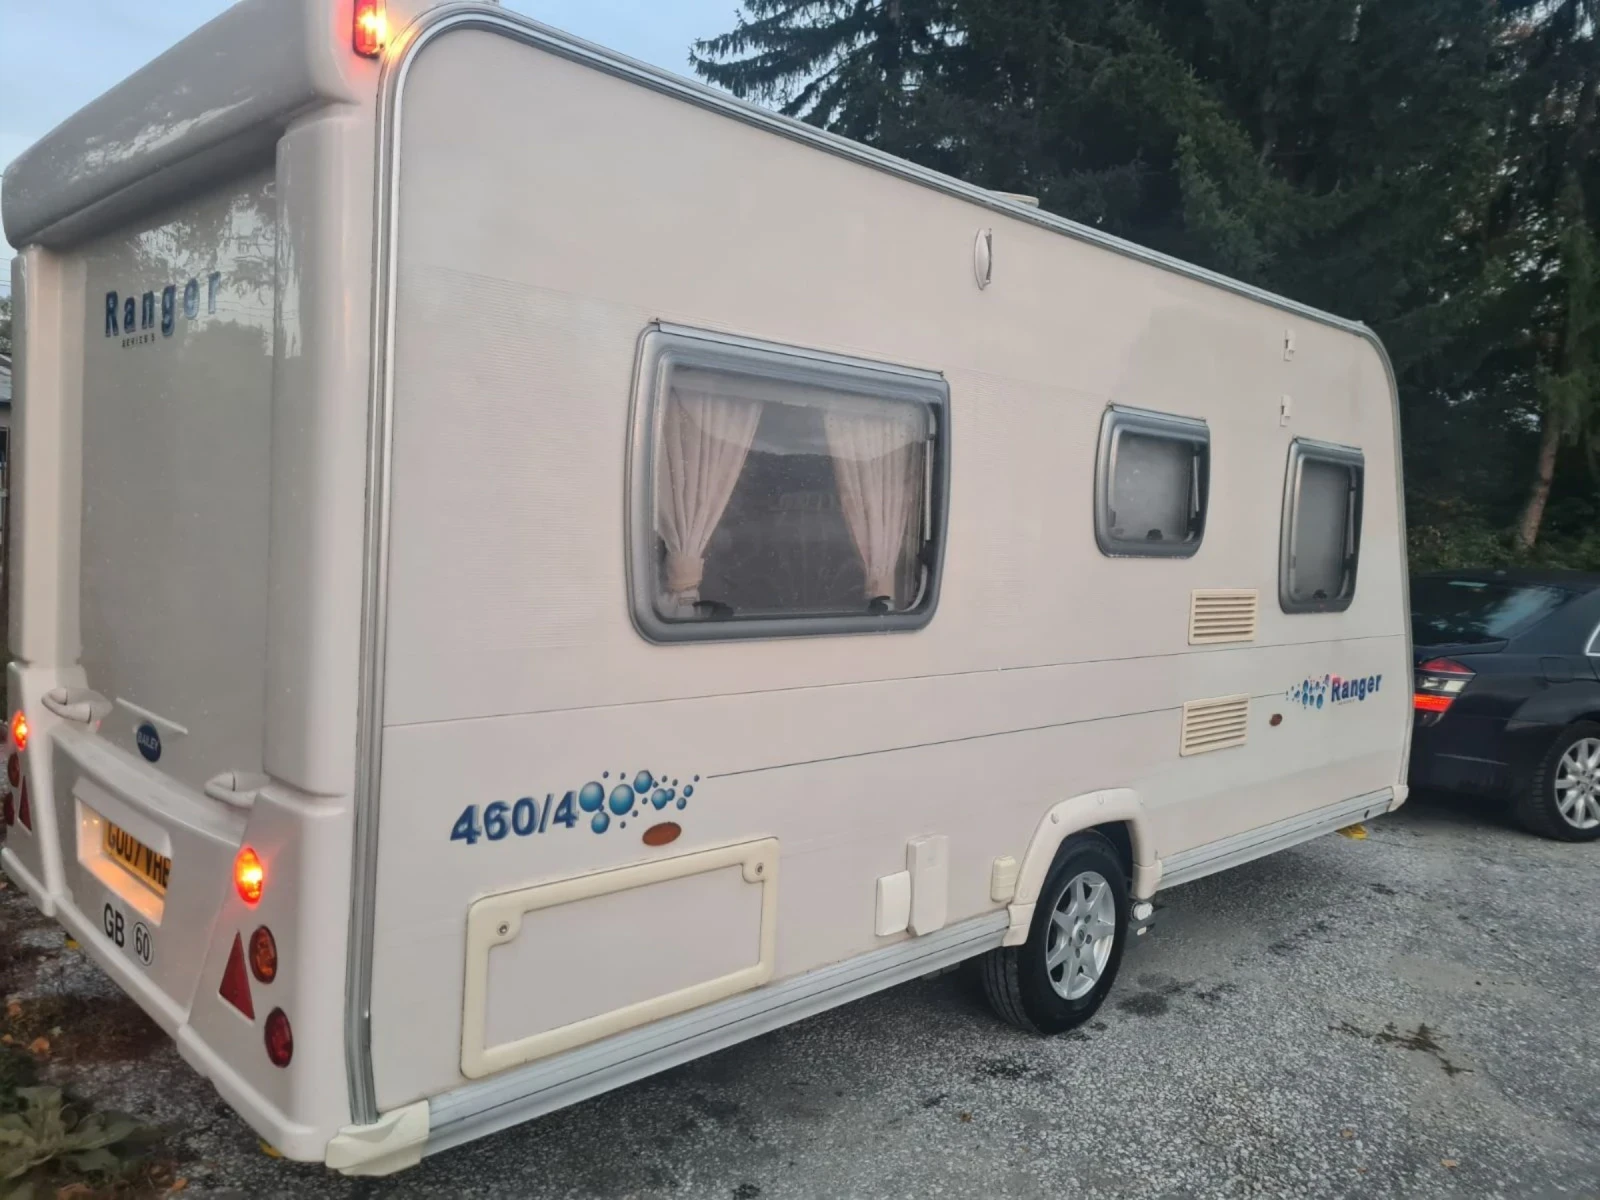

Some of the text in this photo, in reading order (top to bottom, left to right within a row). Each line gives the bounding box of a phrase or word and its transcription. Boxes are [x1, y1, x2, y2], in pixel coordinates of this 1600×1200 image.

[105, 270, 221, 338] Ranger
[1331, 674, 1382, 702] Ranger
[450, 790, 579, 845] 460/4
[104, 902, 125, 948] GB
[136, 926, 150, 962] 60
